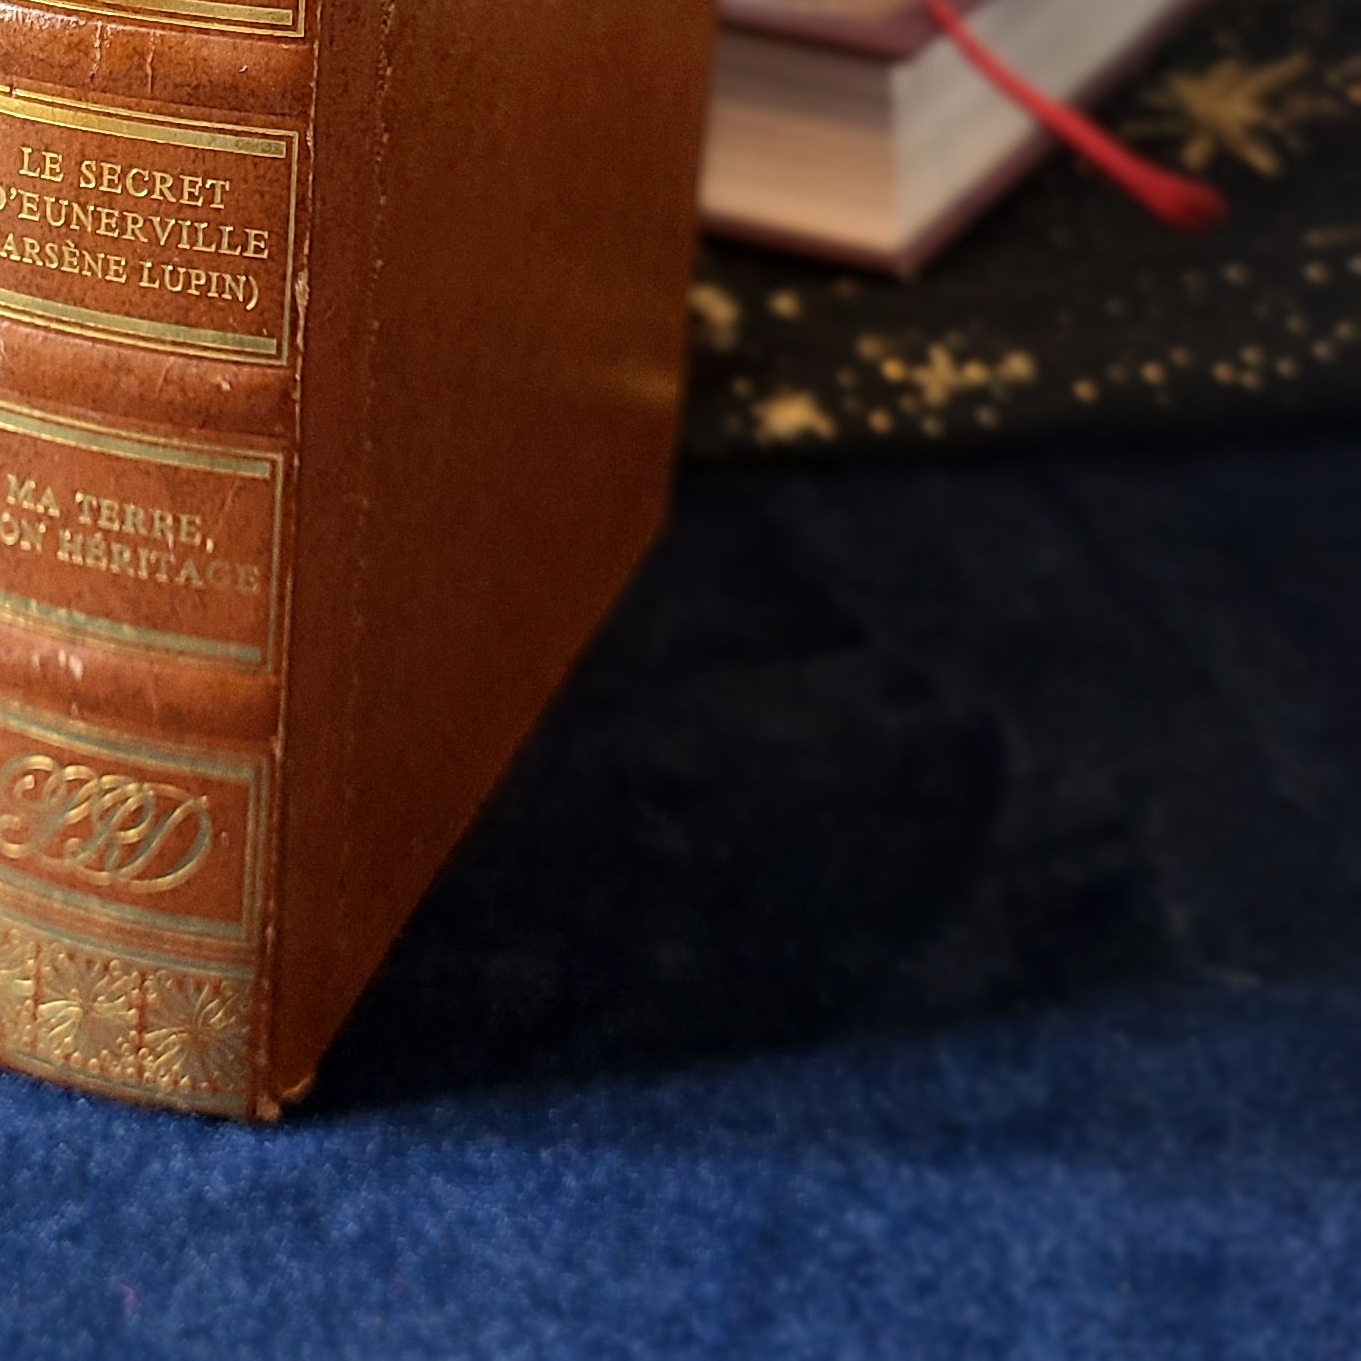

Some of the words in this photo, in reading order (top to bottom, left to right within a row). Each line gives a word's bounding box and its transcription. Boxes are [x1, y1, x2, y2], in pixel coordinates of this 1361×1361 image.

[18, 146, 64, 182] LE
[79, 159, 230, 209] SECRET
[139, 260, 260, 311] LUPIN)
[6, 473, 60, 518] MA
[75, 491, 215, 554] TERRE,
[57, 528, 260, 595] HÉRITAGE
